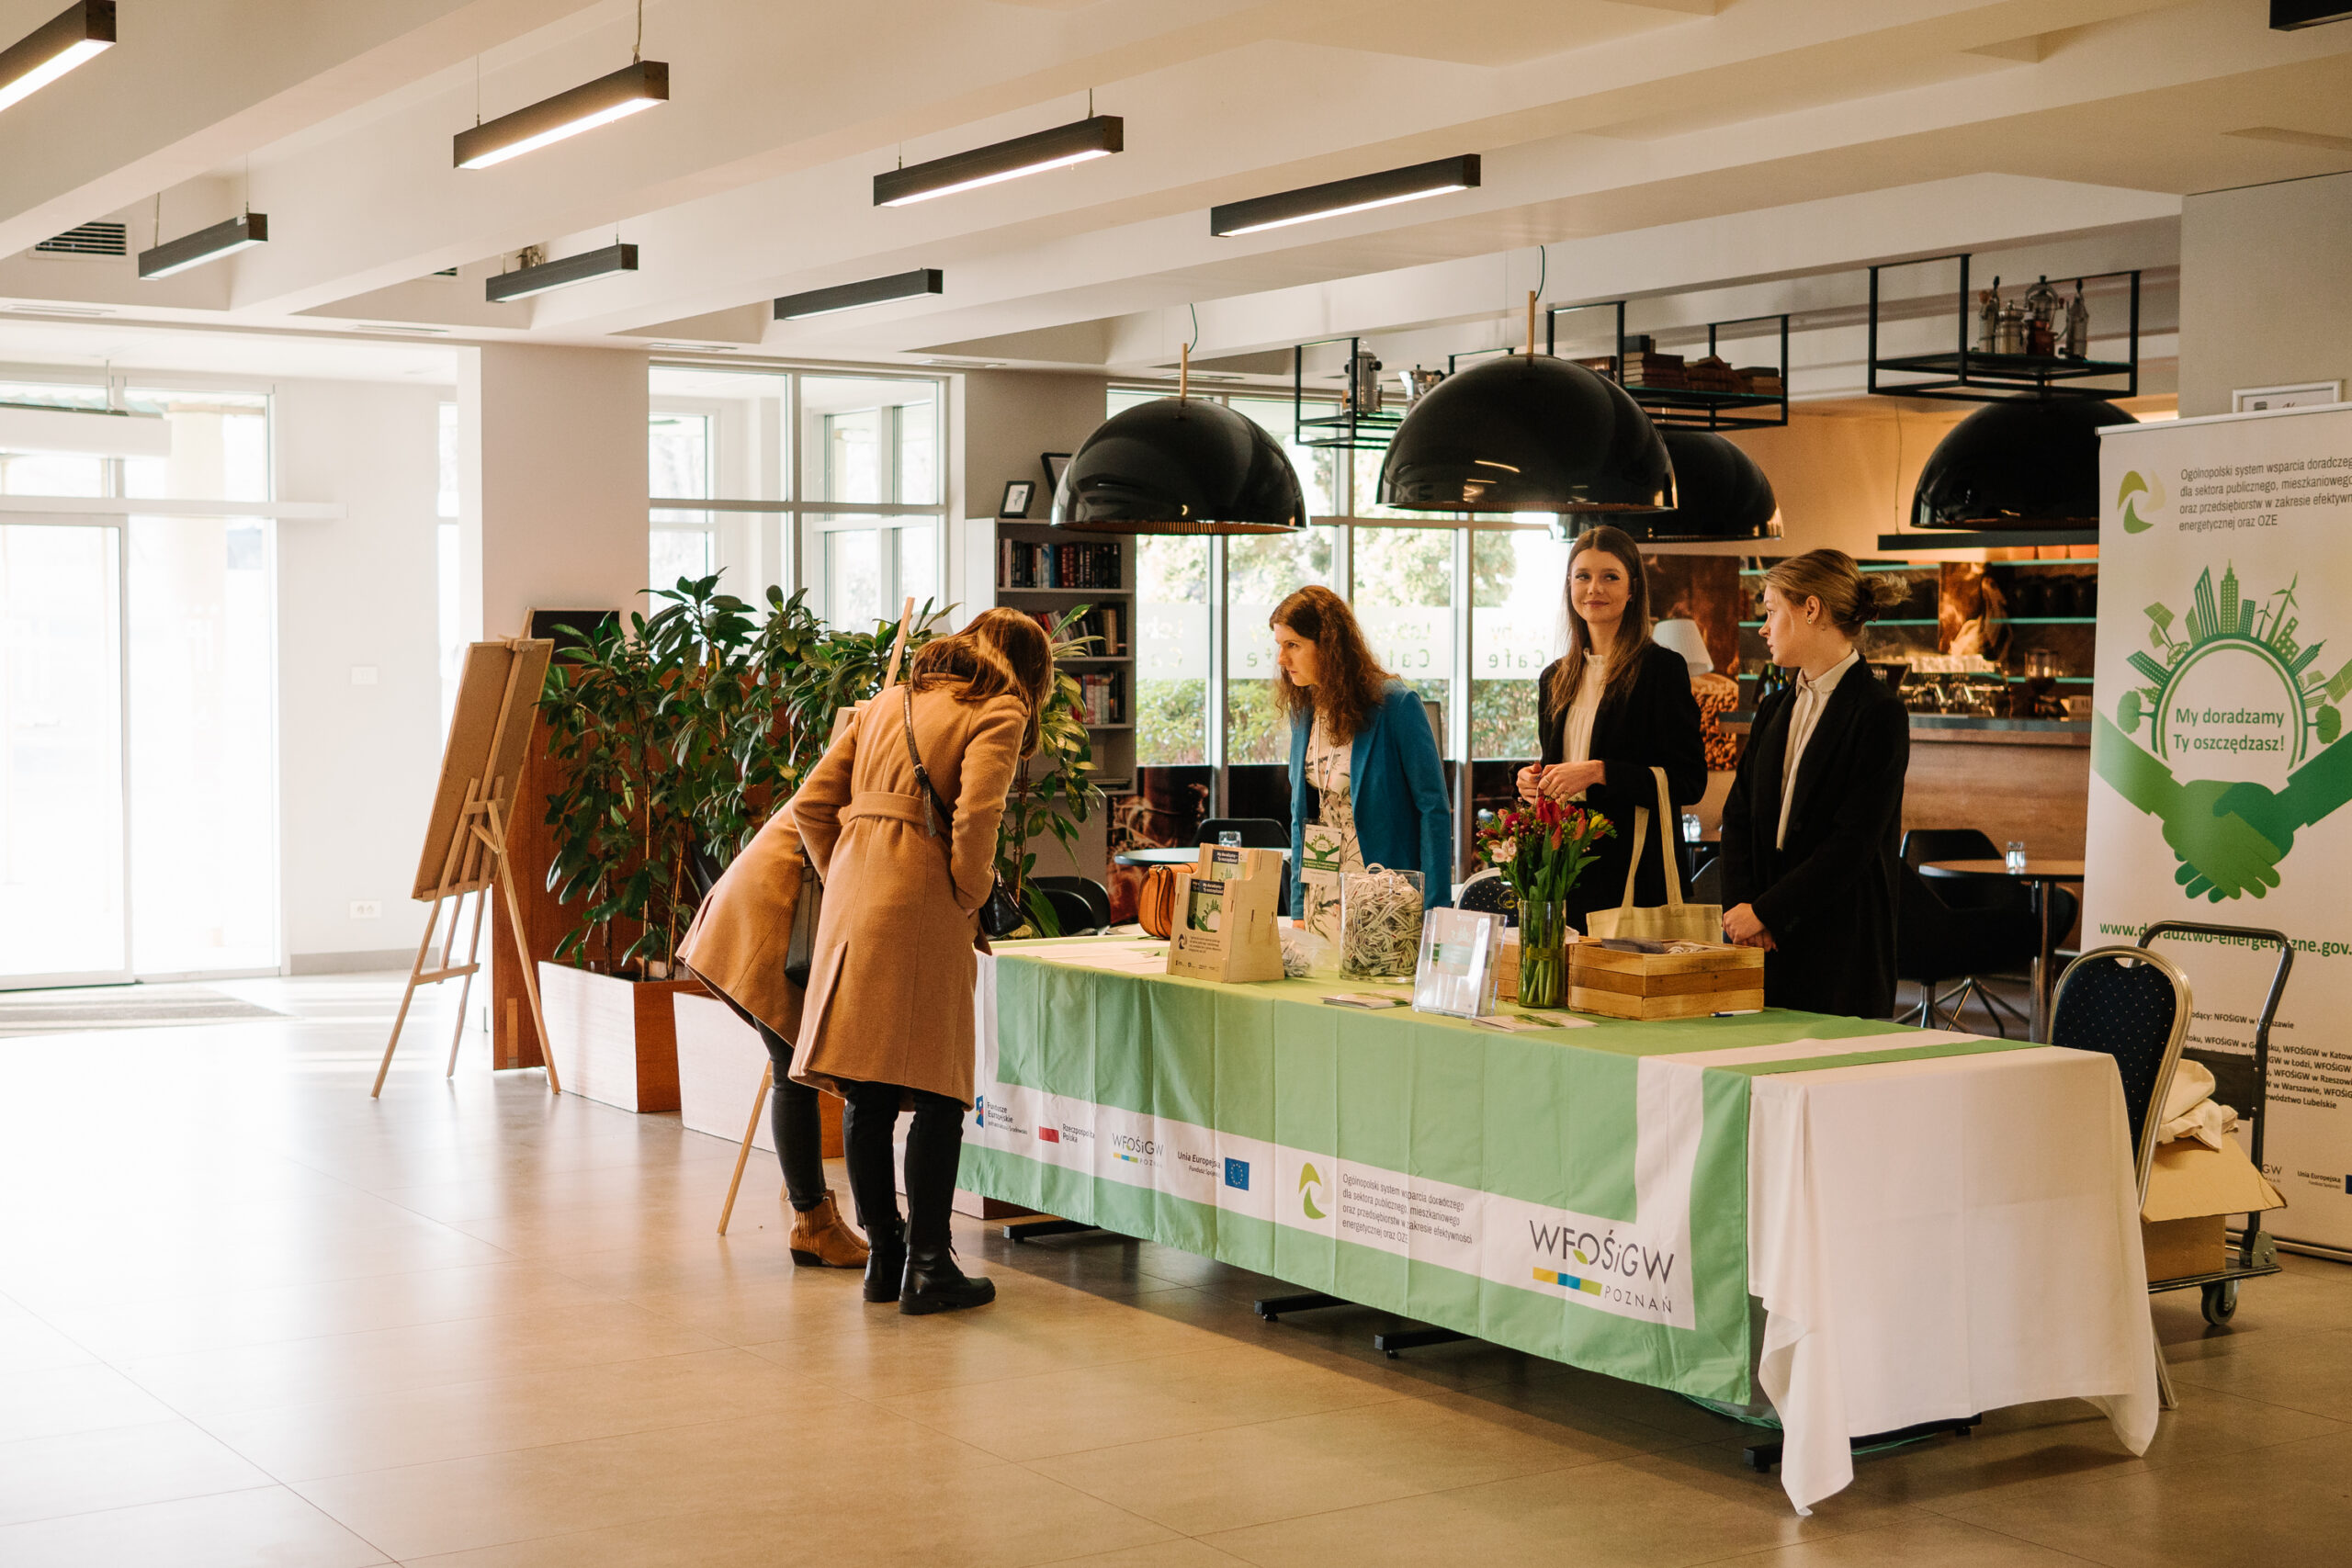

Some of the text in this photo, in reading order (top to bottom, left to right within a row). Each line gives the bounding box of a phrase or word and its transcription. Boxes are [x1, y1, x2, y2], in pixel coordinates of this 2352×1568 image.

[2180, 465, 2233, 482] Ogólnopolski
[2234, 463, 2264, 478] system
[2266, 460, 2304, 474] wsparcia
[2180, 485, 2193, 497] dla
[2194, 484, 2224, 496] sektora
[2226, 480, 2278, 496] publicznego,
[2179, 505, 2197, 514] oraz
[2199, 499, 2263, 515] przedsiębiorstw
[2265, 500, 2272, 508] w
[2275, 495, 2311, 508] zakresie
[2178, 514, 2278, 533] energetycznej oraz OZE
[2176, 707, 2285, 728] My doradzamy
[2173, 734, 2285, 754] Ty oszczędzasz!
[2214, 1011, 2247, 1024] NFOŚiGW
[2204, 1036, 2239, 1047] WFOŚiGW
[2283, 1043, 2320, 1056] WFOŚiGW
[2274, 1067, 2311, 1080] WFOŚiGW
[2291, 1057, 2312, 1069] Łodzi,
[2313, 1060, 2351, 1073] WFOŚiGW
[2281, 1081, 2322, 1096] Warszawie,
[2302, 1095, 2337, 1110] Lubelskie
[1062, 1132, 1078, 1143] Polska
[1112, 1133, 1164, 1157] WFOŚiGW
[1177, 1150, 1191, 1162] Unia
[2297, 1169, 2341, 1183] Unia Europejska
[1342, 1173, 1464, 1213] Ogólnopolski system wsparcia doradczego
[1342, 1189, 1351, 1200] dla
[1353, 1190, 1374, 1205] sektora
[1409, 1206, 1461, 1227] mieszkaniowego
[1342, 1204, 1356, 1214] oraz
[1357, 1207, 1400, 1227] przedsiębiorstw
[1433, 1226, 1473, 1245] efektywności
[1342, 1218, 1408, 1244] energetycznej oraz OZE
[1529, 1219, 1675, 1285] WFOŚiGW
[1604, 1285, 1672, 1314] POZNAŃ
